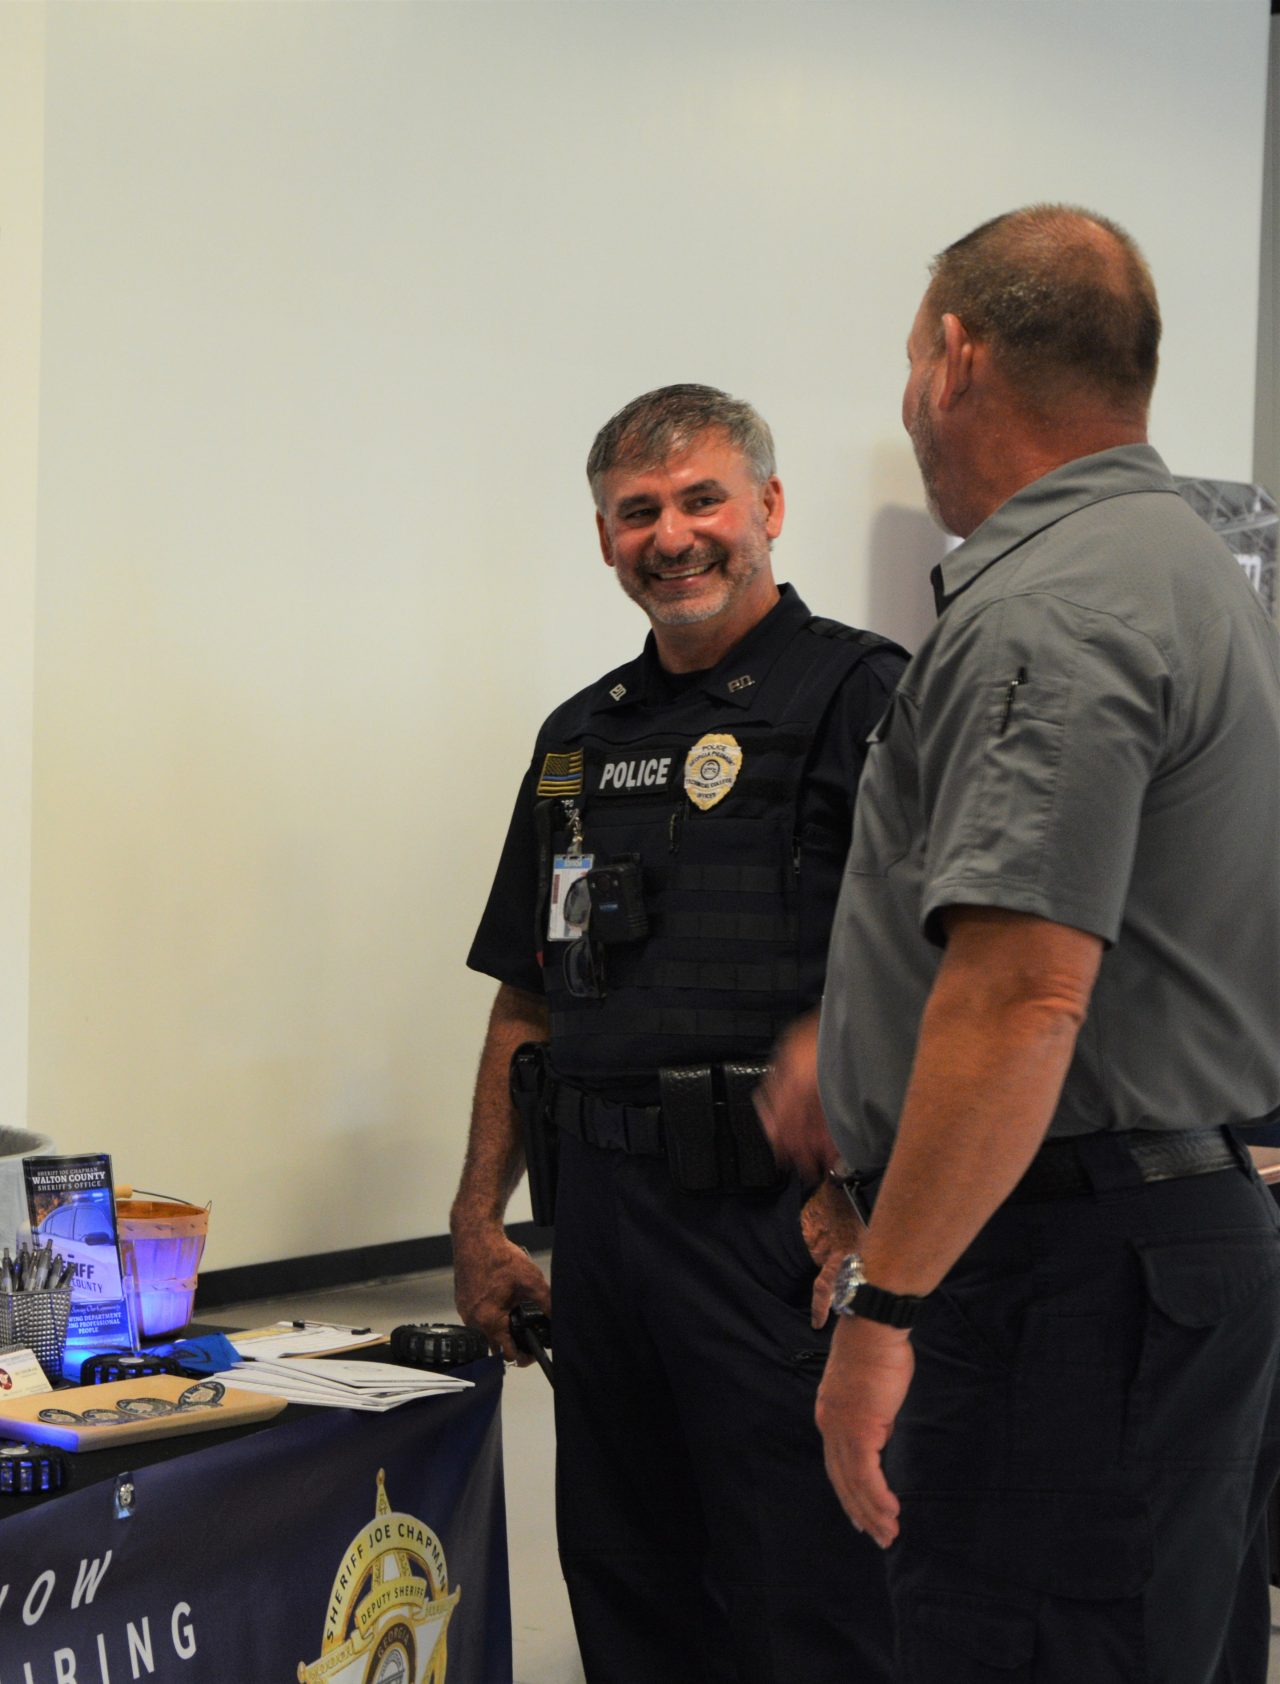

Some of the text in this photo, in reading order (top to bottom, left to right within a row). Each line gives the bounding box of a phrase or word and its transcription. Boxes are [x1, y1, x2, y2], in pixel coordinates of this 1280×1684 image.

[599, 757, 672, 789] POLICE
[32, 1171, 105, 1184] WALTON COUNTY
[80, 1318, 121, 1328] PROFESSIONAL
[84, 1311, 121, 1321] DEPARTMENT
[326, 1523, 446, 1643] SHERIFF JOE CHAPMAN
[361, 1586, 425, 1625] DEPUTY SHERIFF
[377, 1626, 409, 1658] GEORGIA
